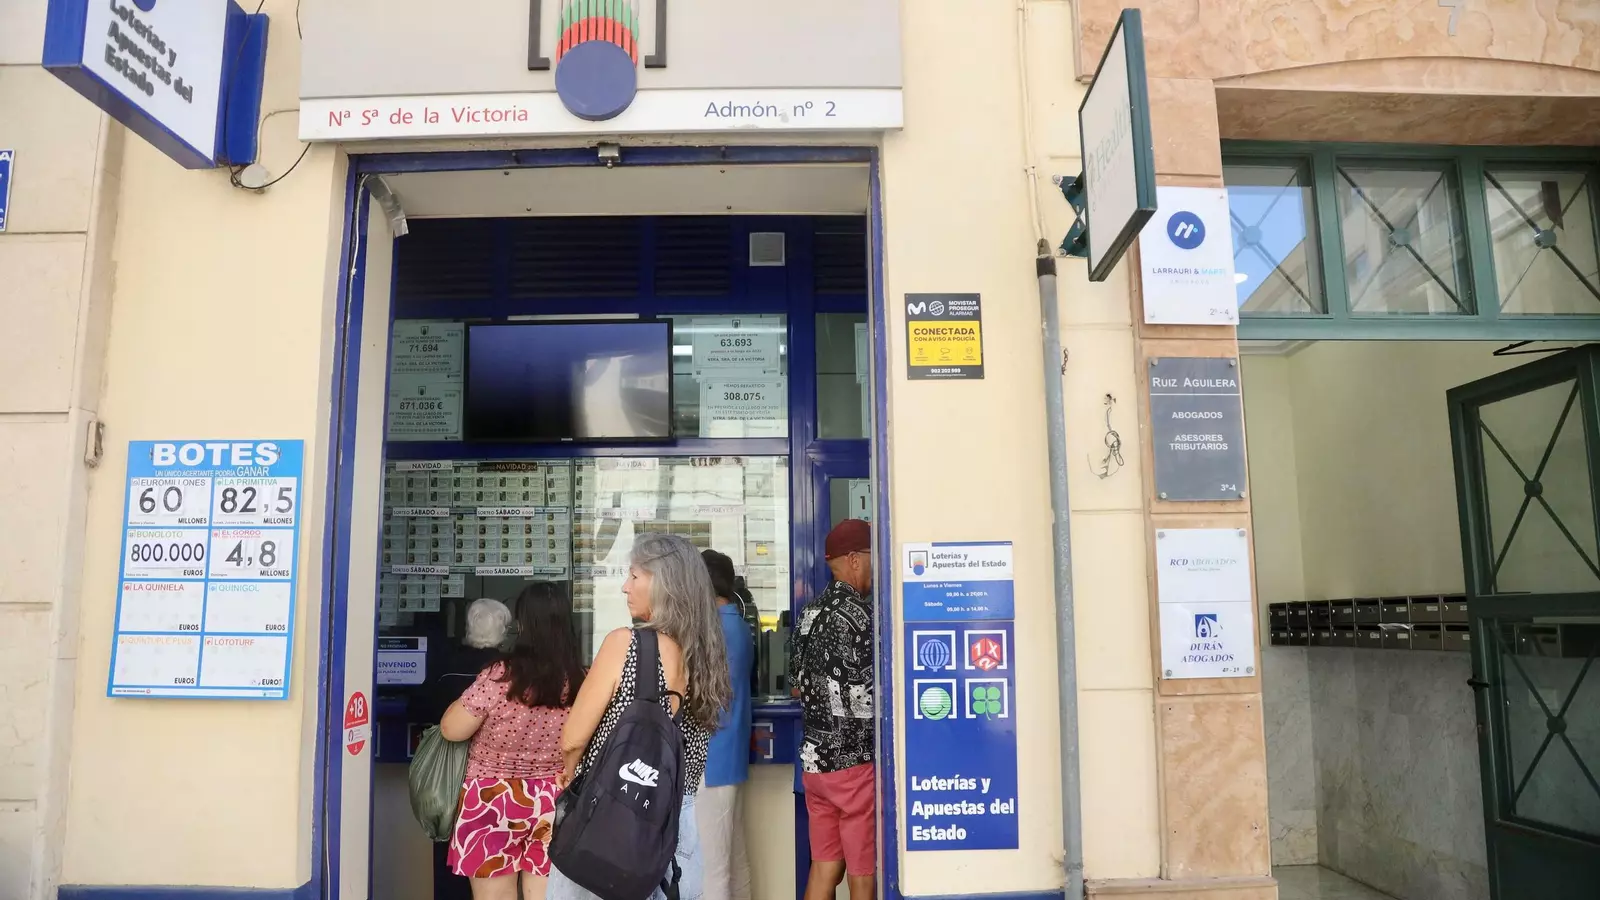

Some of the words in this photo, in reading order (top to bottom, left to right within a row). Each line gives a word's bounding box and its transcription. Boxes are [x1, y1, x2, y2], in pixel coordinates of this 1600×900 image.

[110, 0, 166, 55] Loterías
[167, 47, 177, 68] y
[107, 20, 172, 86] Apuestas
[173, 76, 193, 104] del
[104, 43, 155, 97] Estado
[793, 101, 814, 117] nº
[825, 101, 837, 117] 2
[328, 110, 351, 127] Nª
[361, 109, 379, 126] Sª
[389, 107, 414, 124] de
[424, 107, 440, 124] la
[451, 105, 529, 123] Victoria
[1152, 267, 1192, 275] LARRAURI
[913, 328, 976, 336] CONECTADA
[720, 338, 752, 347] 63.693
[408, 343, 439, 353] 71.694
[723, 392, 761, 401] 308.075
[399, 401, 435, 410] 871.036
[437, 401, 444, 410] €
[1171, 411, 1223, 419] ABOGADOS
[1174, 434, 1223, 442] ASESORES
[153, 442, 278, 467] BOTES
[411, 462, 442, 470] NAVIDAD
[495, 462, 527, 471] NAVIDAD
[236, 466, 270, 477] GANAR
[178, 517, 208, 525] MILLONES
[263, 517, 293, 525] MILLONES
[131, 543, 205, 562] 800.000
[931, 552, 962, 560] Loterías
[932, 562, 966, 570] Apuestas
[968, 560, 979, 568] del
[982, 560, 1007, 568] Estado
[1169, 558, 1189, 566] RCD
[183, 569, 204, 577] EUROS
[259, 569, 289, 577] MILLONES
[133, 583, 143, 591] LA
[145, 583, 184, 591] QUINIELA
[218, 584, 260, 592] QUINIGOL
[1190, 640, 1223, 651] DURÁN
[1180, 654, 1235, 663] ABOGADOS
[349, 696, 364, 719] +18
[628, 758, 660, 781] NIKE
[911, 774, 977, 791] Loterías
[981, 776, 991, 793] y
[911, 801, 985, 820] Apuestas
[989, 798, 1015, 814] del
[912, 824, 967, 841] Estado
